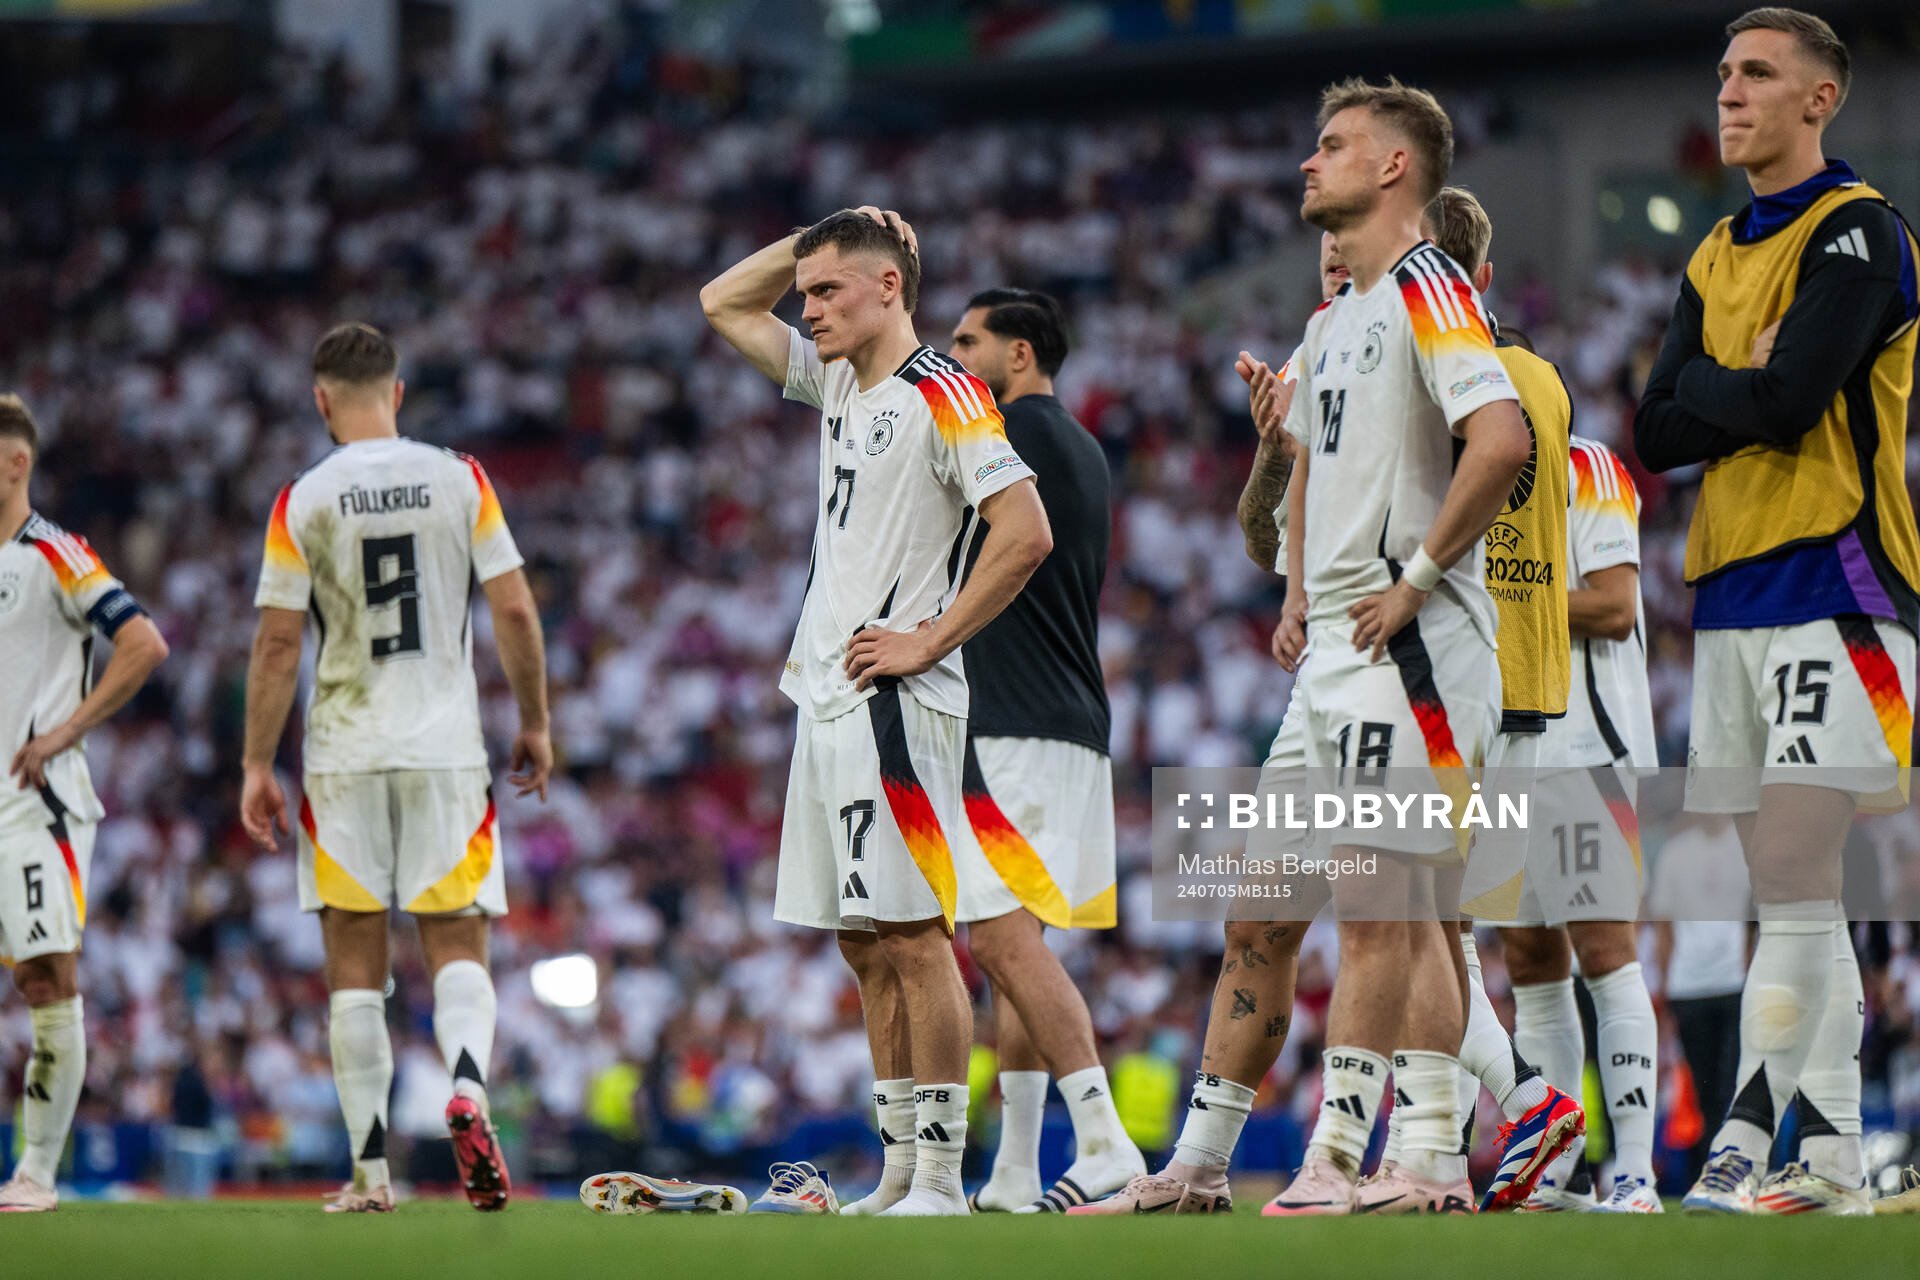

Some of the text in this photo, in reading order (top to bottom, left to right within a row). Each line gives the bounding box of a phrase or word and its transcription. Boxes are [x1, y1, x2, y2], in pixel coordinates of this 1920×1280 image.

[1317, 389, 1346, 456] 18
[339, 484, 430, 517] FÜLLKRUG
[362, 533, 424, 660] 9
[1486, 557, 1553, 586] RO2024
[1772, 660, 1832, 727] 15
[1338, 721, 1395, 789] 18
[840, 800, 876, 861] 17
[1552, 822, 1600, 877] 16
[23, 863, 43, 911] 6
[1332, 1056, 1374, 1076] DFB
[1612, 1053, 1651, 1069] DFB
[915, 1090, 950, 1104] DFB
